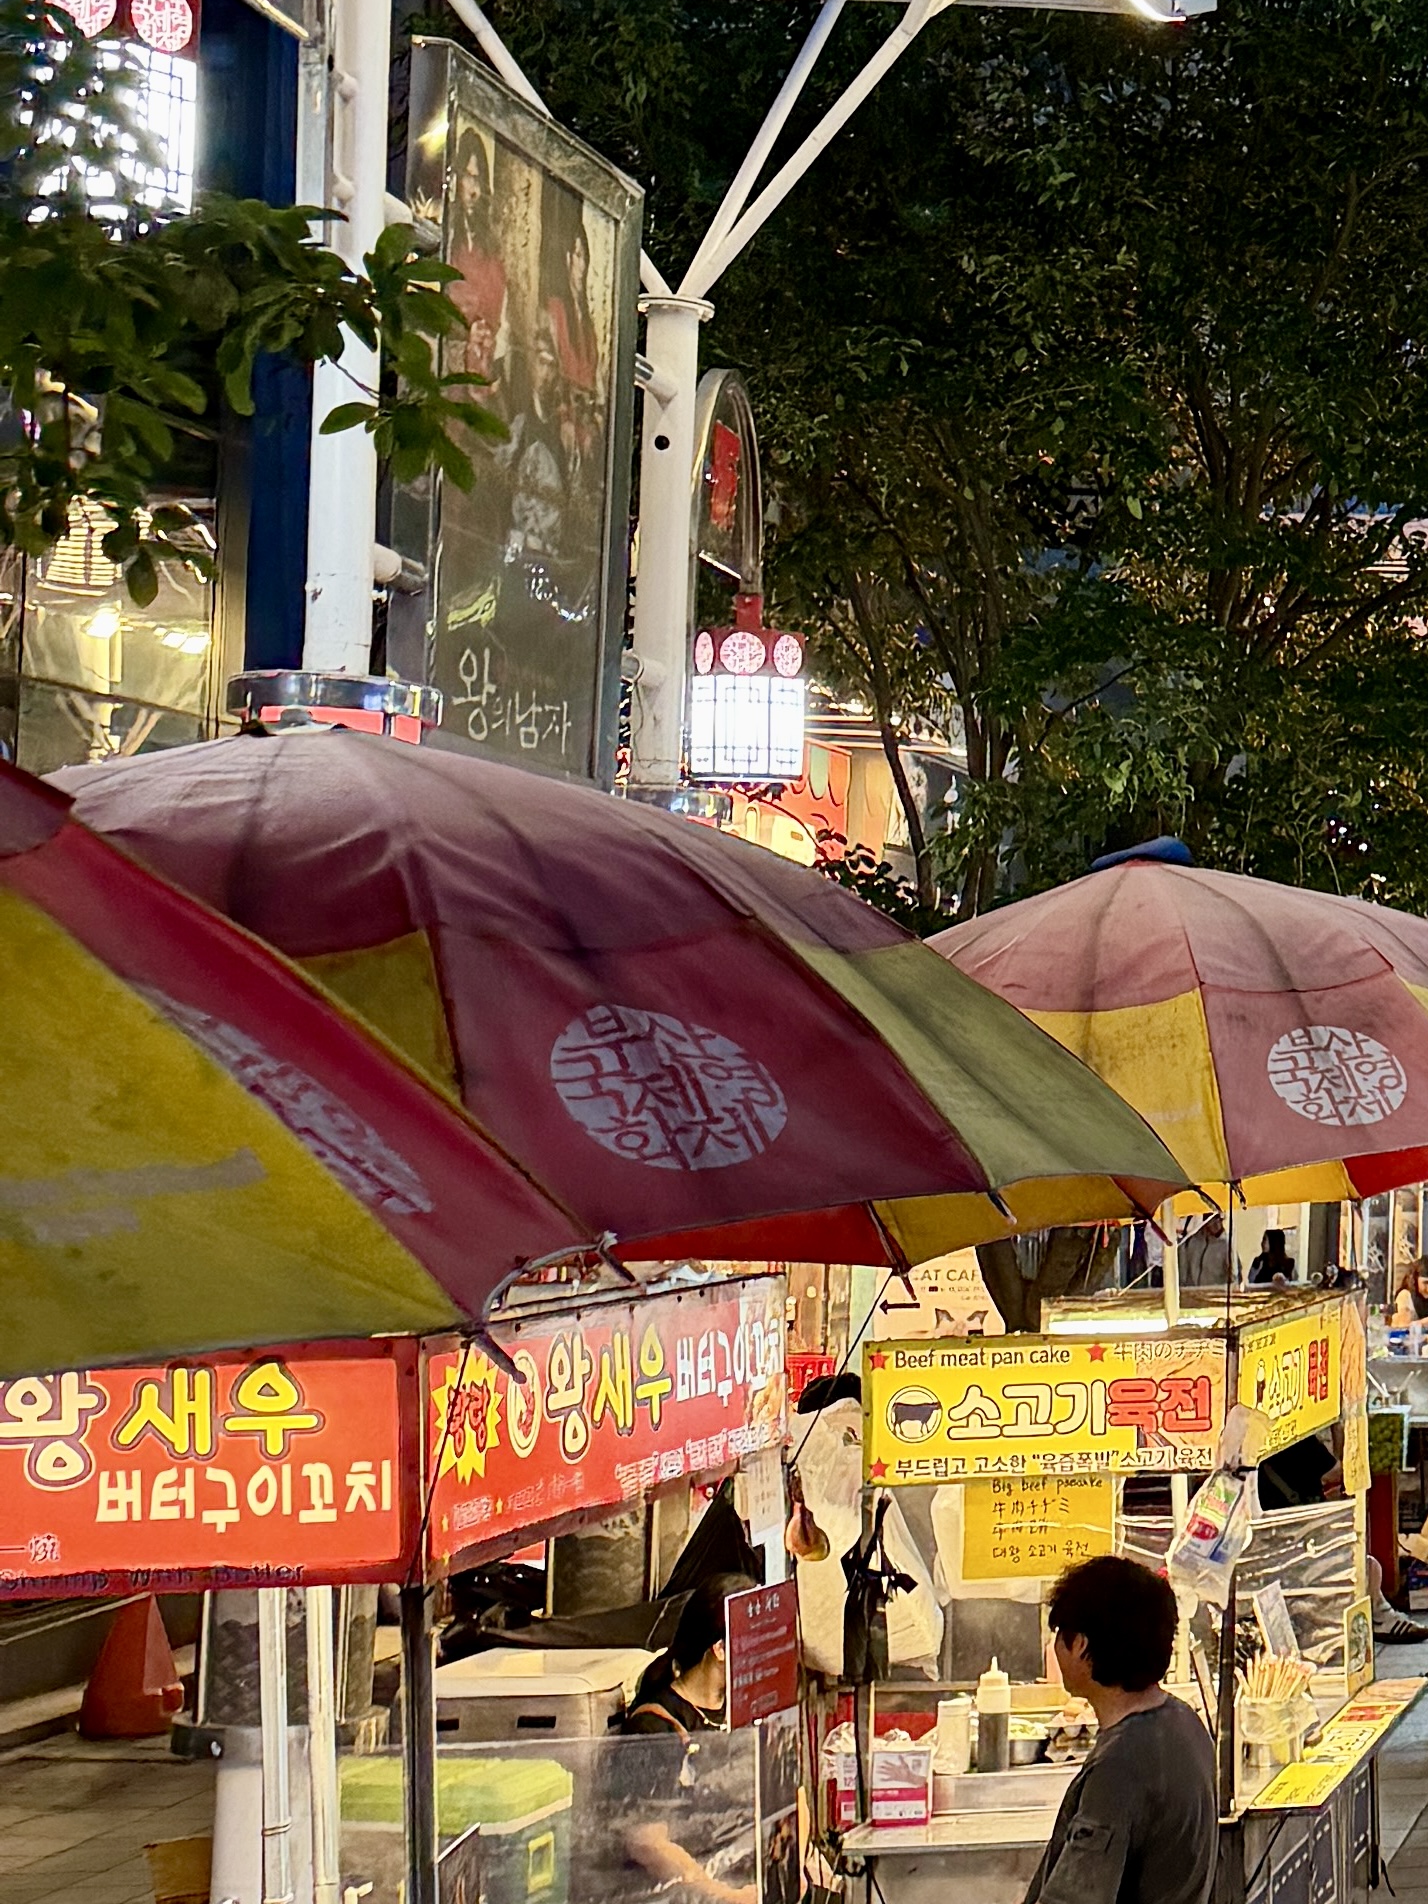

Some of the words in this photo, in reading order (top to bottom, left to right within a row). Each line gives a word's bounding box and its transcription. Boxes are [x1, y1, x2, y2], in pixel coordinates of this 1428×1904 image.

[452, 647, 571, 756] 왕의남자
[894, 1349, 935, 1370] Beef
[940, 1347, 988, 1367] meat
[991, 1350, 1024, 1367] pan
[1029, 1349, 1071, 1364] cake
[946, 1376, 1213, 1442] 소고기육전
[894, 1459, 968, 1478] 부드럽고
[974, 1456, 1027, 1475] 고소한
[1120, 1449, 1174, 1469] 소고기
[1178, 1447, 1213, 1467] 육전
[95, 1458, 393, 1534] 버터구이꼬치
[993, 1546, 1021, 1563] 대왕
